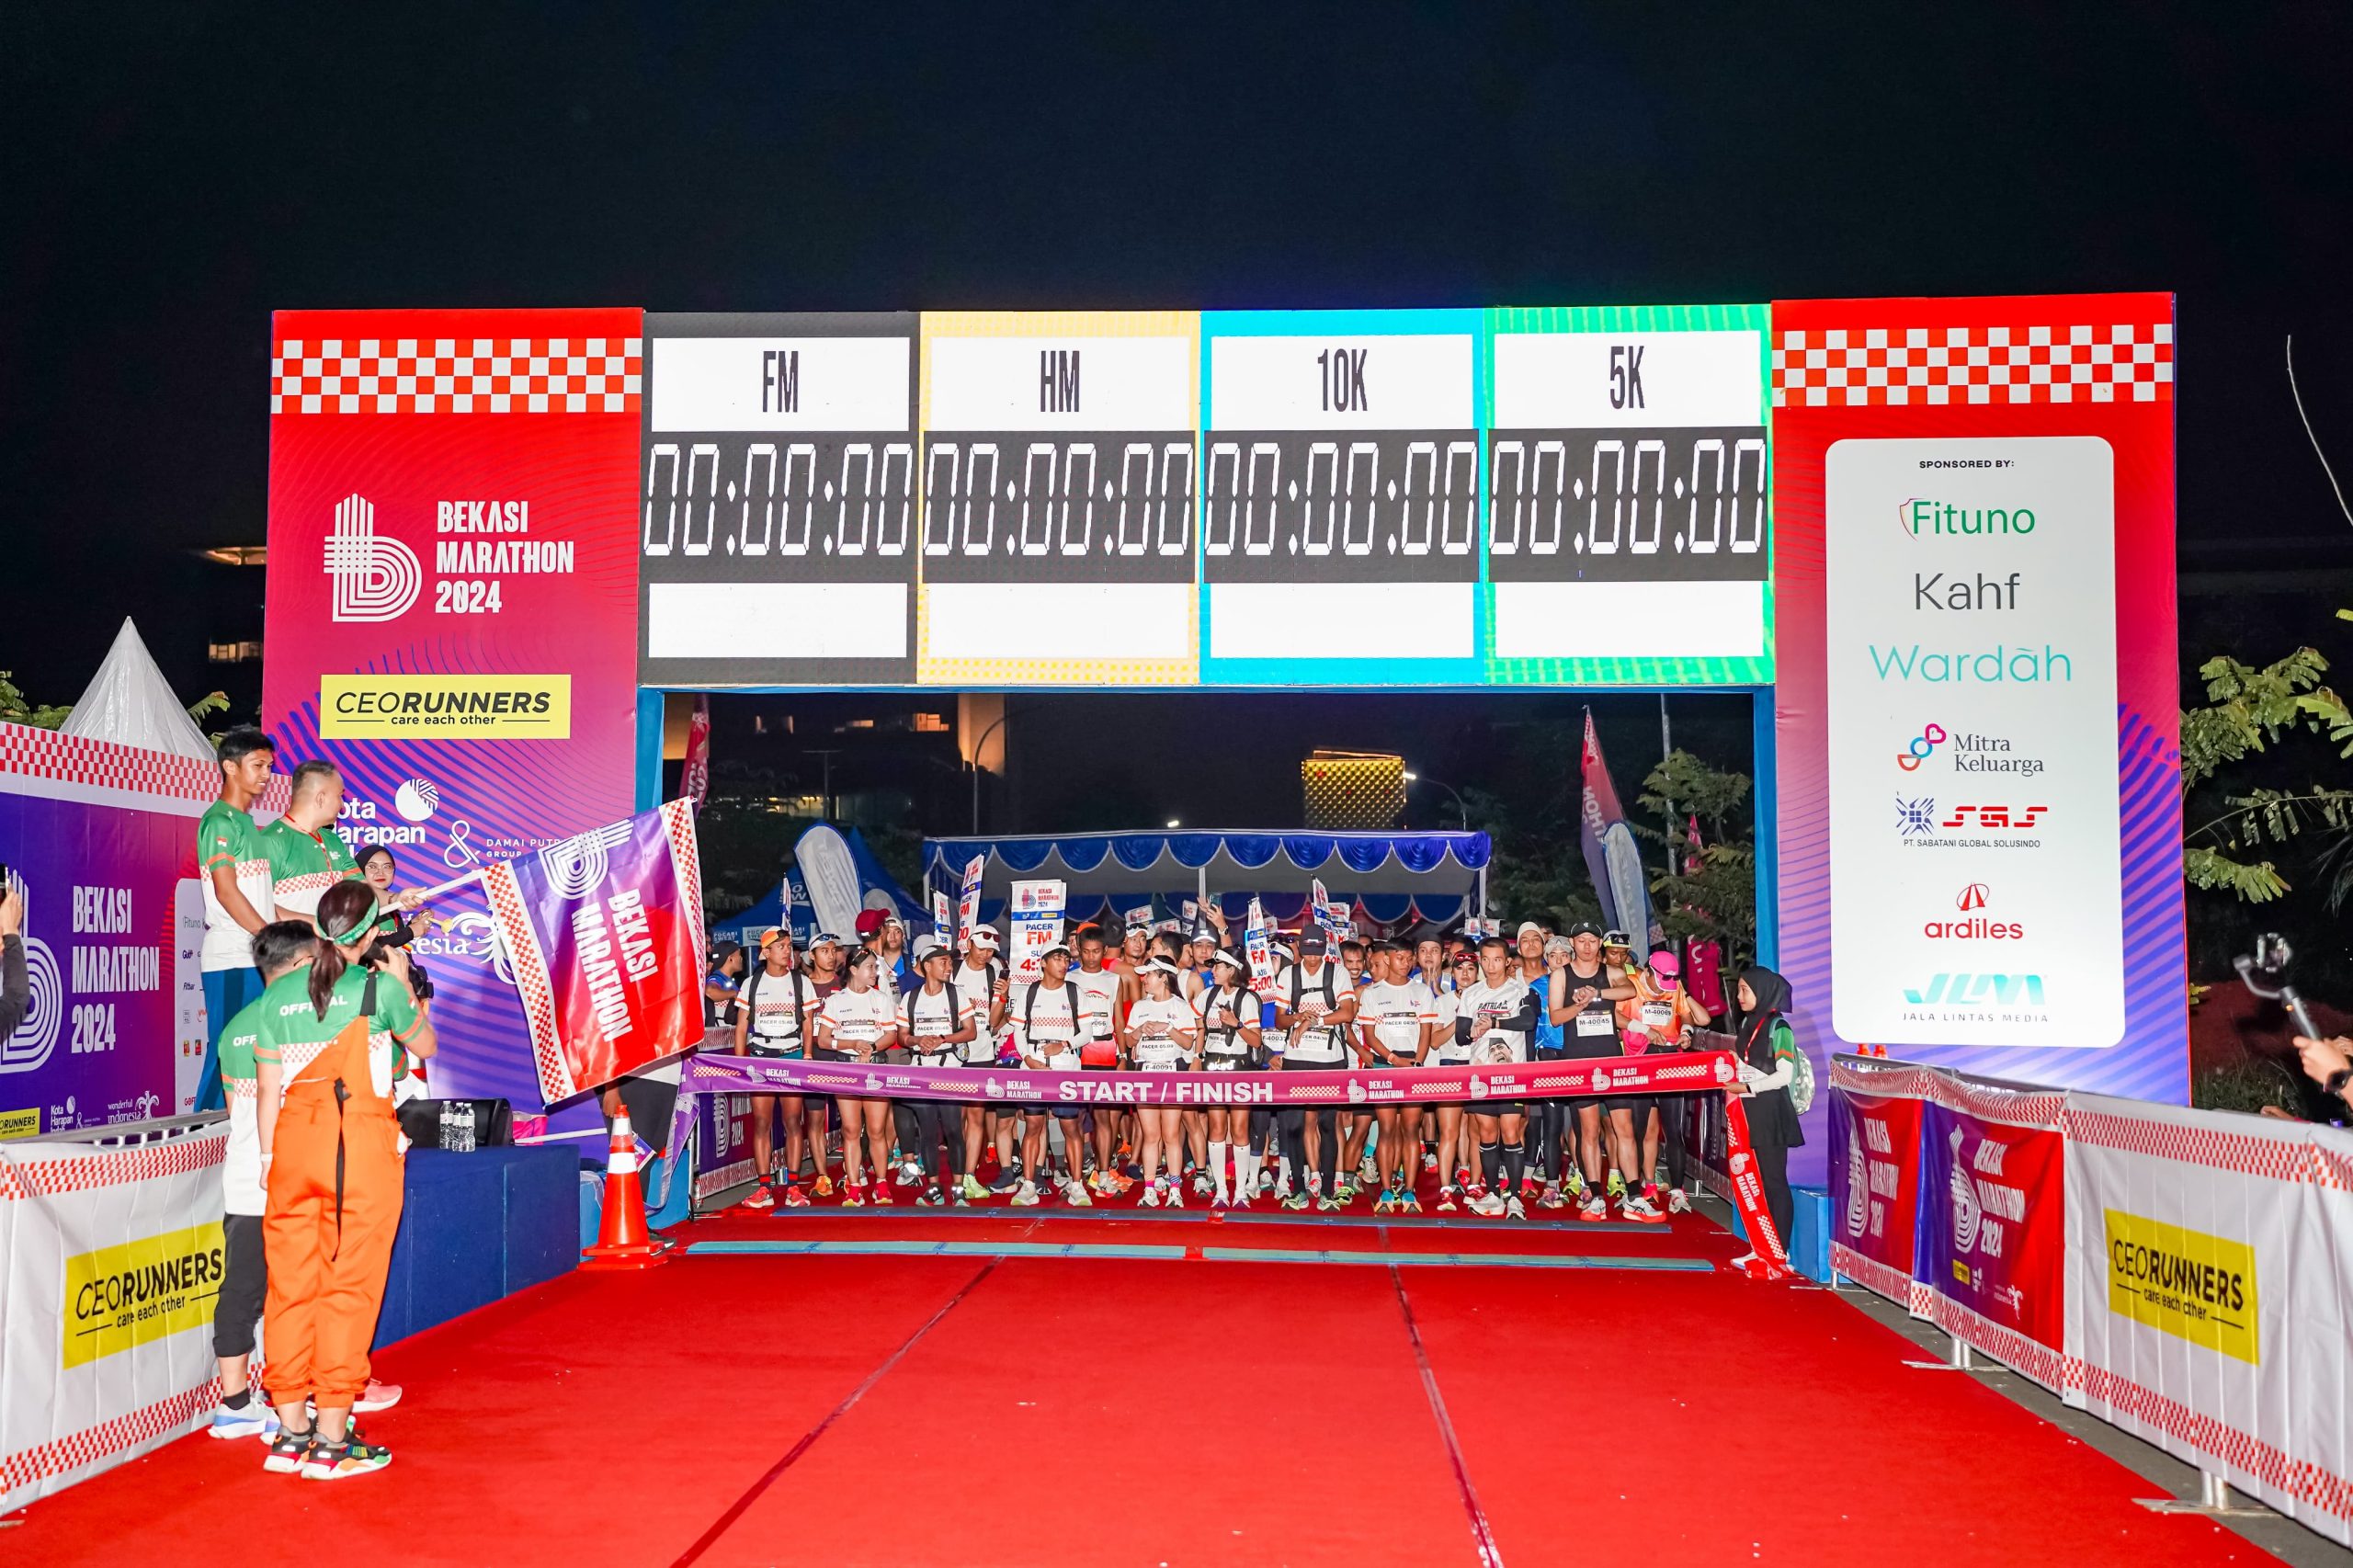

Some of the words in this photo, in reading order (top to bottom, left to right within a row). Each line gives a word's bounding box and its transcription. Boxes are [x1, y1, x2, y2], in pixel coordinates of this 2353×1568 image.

[762, 350, 799, 413] FM
[1040, 350, 1080, 413] HM
[1316, 348, 1368, 412] 10K
[1609, 346, 1645, 409] 5K
[1918, 460, 1993, 469] SPONSORED
[1995, 460, 2015, 468] BY:
[643, 443, 913, 556] 00:00:00
[922, 443, 1194, 556] 00:00:00
[1205, 442, 1477, 556] 00:00:00
[1489, 438, 1766, 554] 00:00:00
[437, 501, 529, 533] BEKASI
[1913, 500, 2036, 535] Fituno
[436, 540, 574, 574] MARATHON
[435, 580, 502, 613] 2024
[1915, 573, 2021, 610] Kahf
[335, 691, 551, 713] CEORUNNERS
[391, 716, 421, 725] care
[424, 714, 456, 725] each
[460, 714, 496, 725] other
[1953, 733, 2011, 753] Mitra
[1954, 755, 2045, 778] Keluarga
[336, 797, 376, 820] ota
[335, 822, 426, 846] arapan
[486, 838, 525, 846] DAMAI
[1904, 839, 1915, 847] PT.
[1917, 839, 1956, 847] SABATANI
[1994, 839, 2040, 847] SOLUSINDO
[73, 885, 132, 934] BEKASI
[608, 888, 659, 983] BEKASI
[1027, 931, 1052, 945] FM
[1924, 917, 2024, 940] ardiles
[72, 946, 159, 994] MARATHON
[571, 903, 634, 1043] MARATHON
[1248, 975, 1272, 992] 5:00
[71, 1004, 116, 1054] 2024
[1579, 1017, 1609, 1026] M-40045
[1903, 1012, 1936, 1022] JALA
[1943, 1013, 1995, 1022] LINTAS
[2002, 1013, 2049, 1023] MEDIA
[766, 1068, 790, 1077] BEKASI
[886, 1076, 910, 1085] BEKASI
[1491, 1075, 1515, 1085] BEKASI
[1613, 1067, 1637, 1077] BEKASI
[1613, 1075, 1649, 1087] MARATHON
[1006, 1080, 1030, 1090] BEKASI
[1006, 1090, 1042, 1100] MARATHON
[1059, 1080, 1154, 1102] START
[1160, 1082, 1168, 1102] /
[1176, 1081, 1273, 1103] FINISH
[1369, 1080, 1392, 1090] BEKASI
[1369, 1090, 1404, 1100] MARATHON
[1491, 1085, 1527, 1095] MARATHON
[1736, 1176, 1756, 1212] MARATHON
[1745, 1172, 1760, 1197] BEKASI
[75, 1247, 222, 1322] CEORUNNERS
[2113, 1238, 2245, 1312] CEORUNNERS
[116, 1309, 135, 1328] care
[137, 1301, 159, 1323] each
[161, 1295, 186, 1316] other
[2143, 1287, 2161, 1305] care
[2162, 1290, 2181, 1313] each
